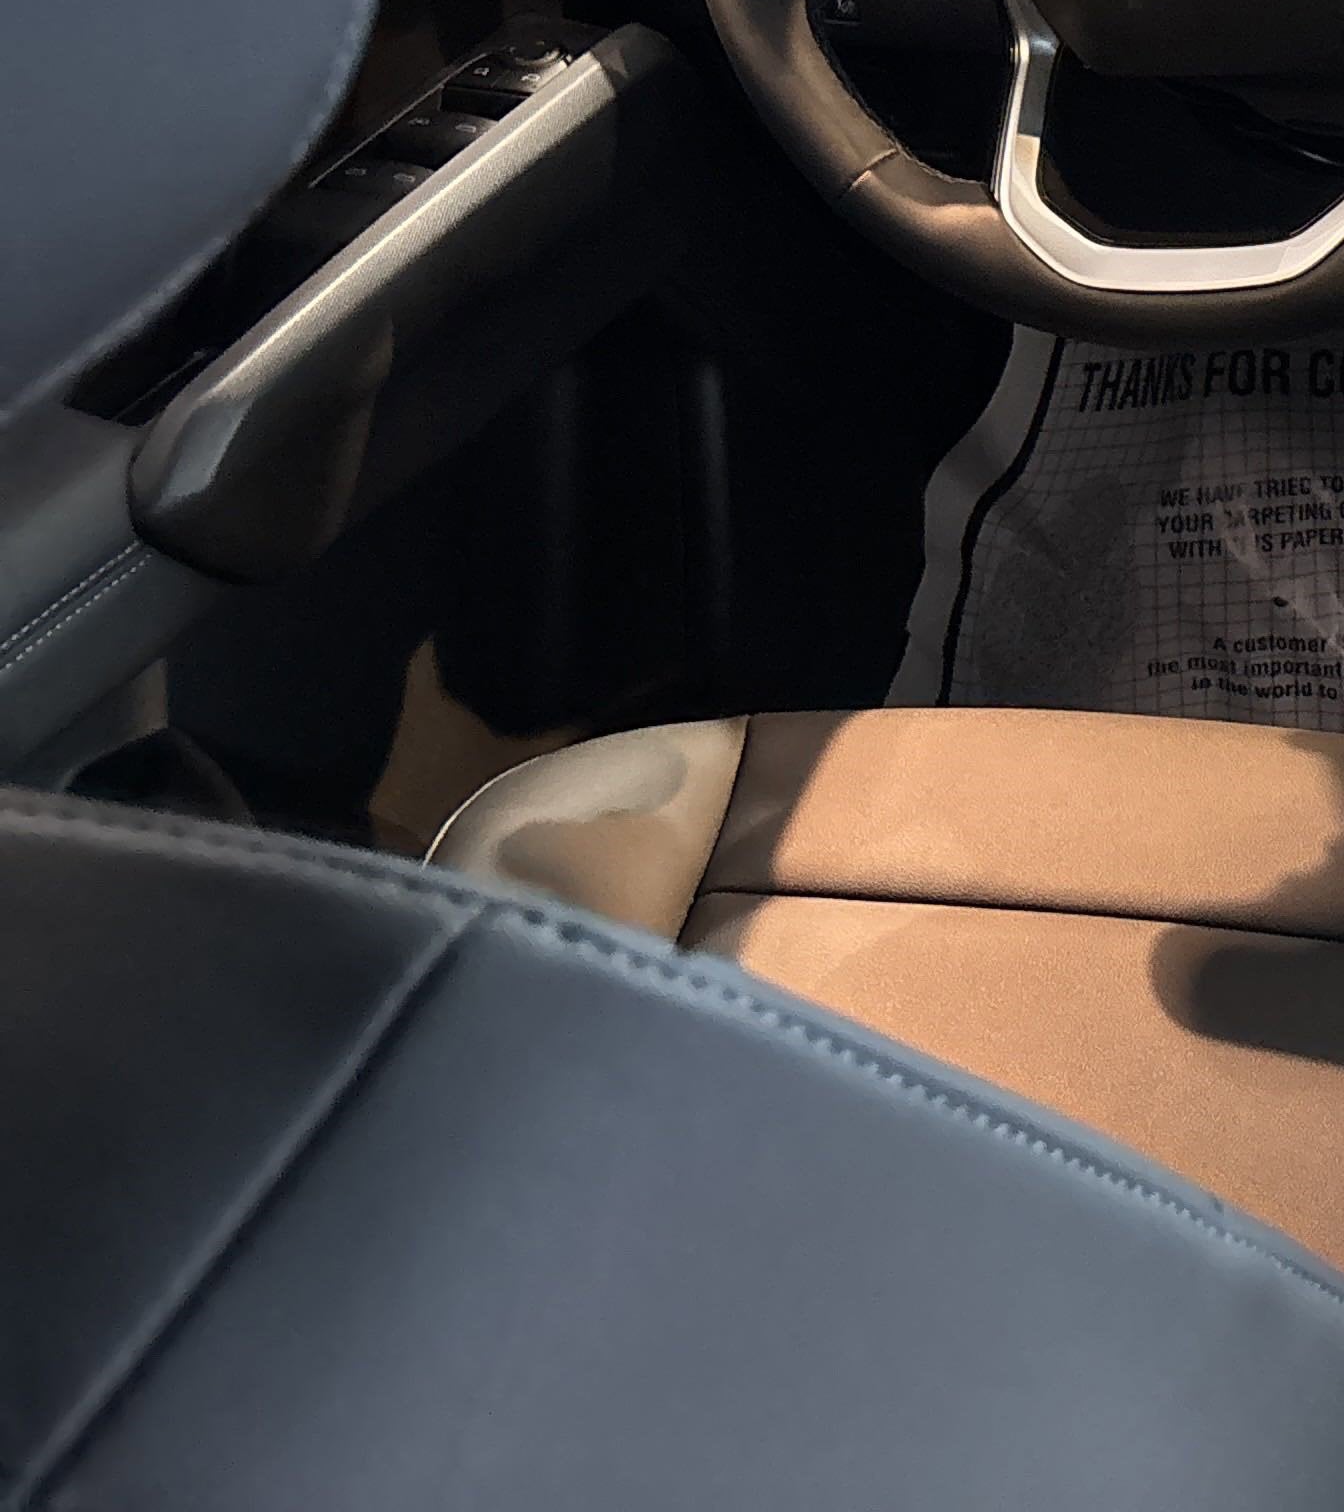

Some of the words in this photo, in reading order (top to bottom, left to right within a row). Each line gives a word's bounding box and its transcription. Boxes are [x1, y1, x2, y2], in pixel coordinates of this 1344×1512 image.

[1079, 352, 1197, 413] THANKS
[1203, 349, 1290, 398] FOR
[1159, 487, 1190, 508] WE
[1320, 474, 1344, 494] TO
[1156, 513, 1214, 534] YOUR
[1169, 539, 1222, 559] WITH
[1279, 528, 1344, 550] PAPER
[1212, 636, 1227, 650] A
[1233, 634, 1328, 654] customer
[1187, 656, 1238, 675] most
[1243, 659, 1342, 679] important
[1218, 676, 1250, 696] the
[1255, 679, 1314, 699] world
[1318, 683, 1338, 700] to
